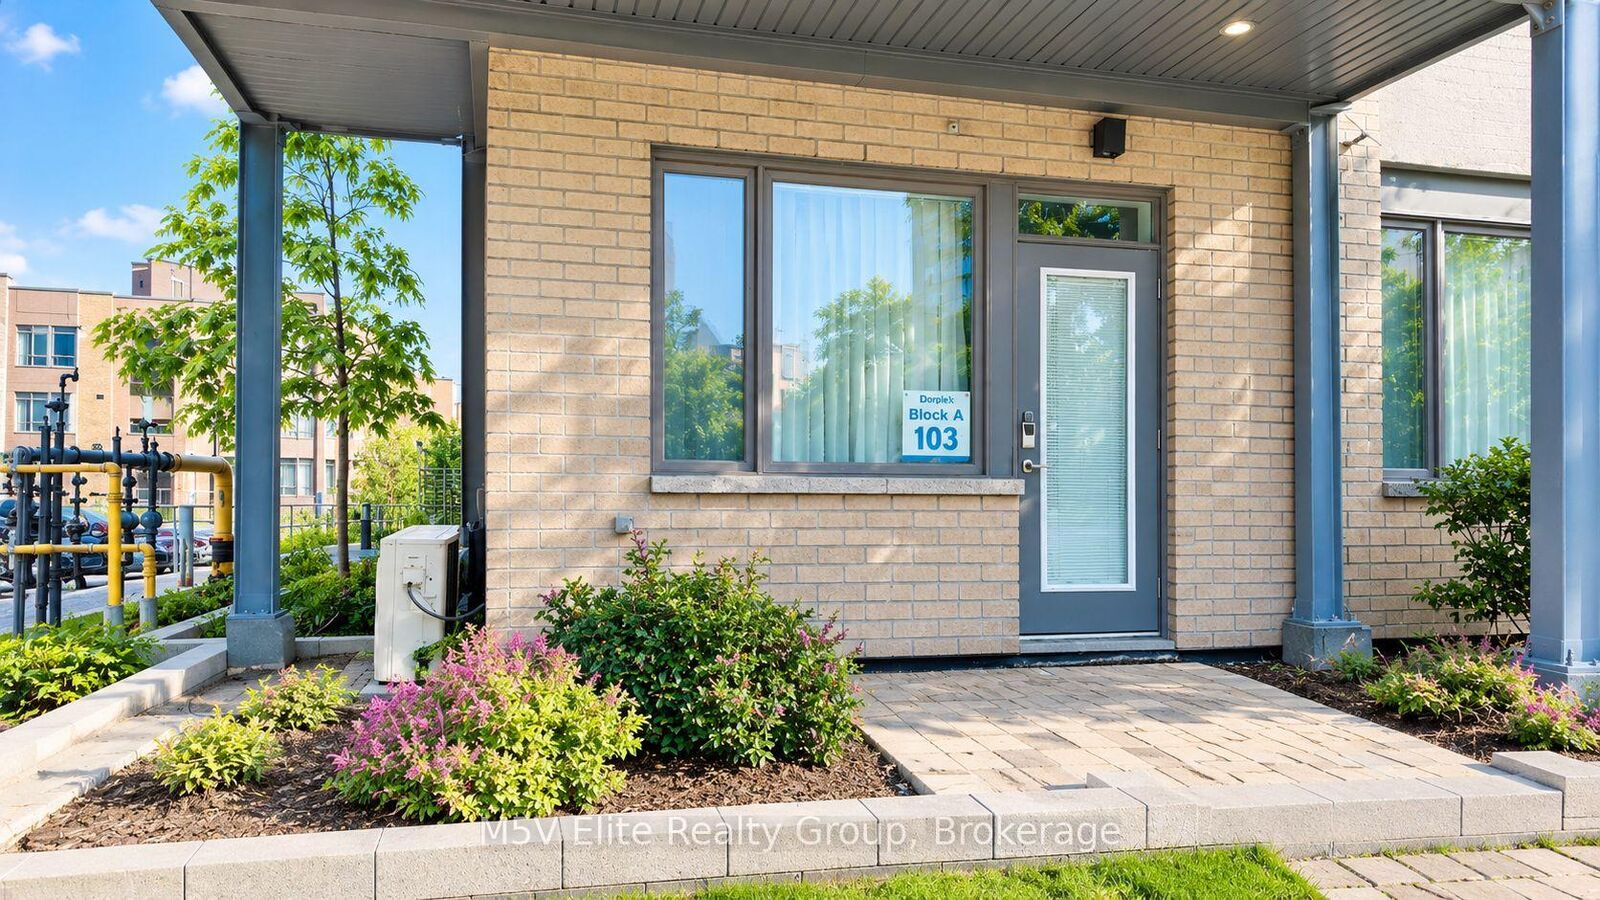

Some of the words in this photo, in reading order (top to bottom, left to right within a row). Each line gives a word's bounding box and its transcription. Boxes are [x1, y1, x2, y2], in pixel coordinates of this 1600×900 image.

[909, 408, 948, 420] Block
[953, 409, 964, 421] A
[914, 426, 958, 450] 103
